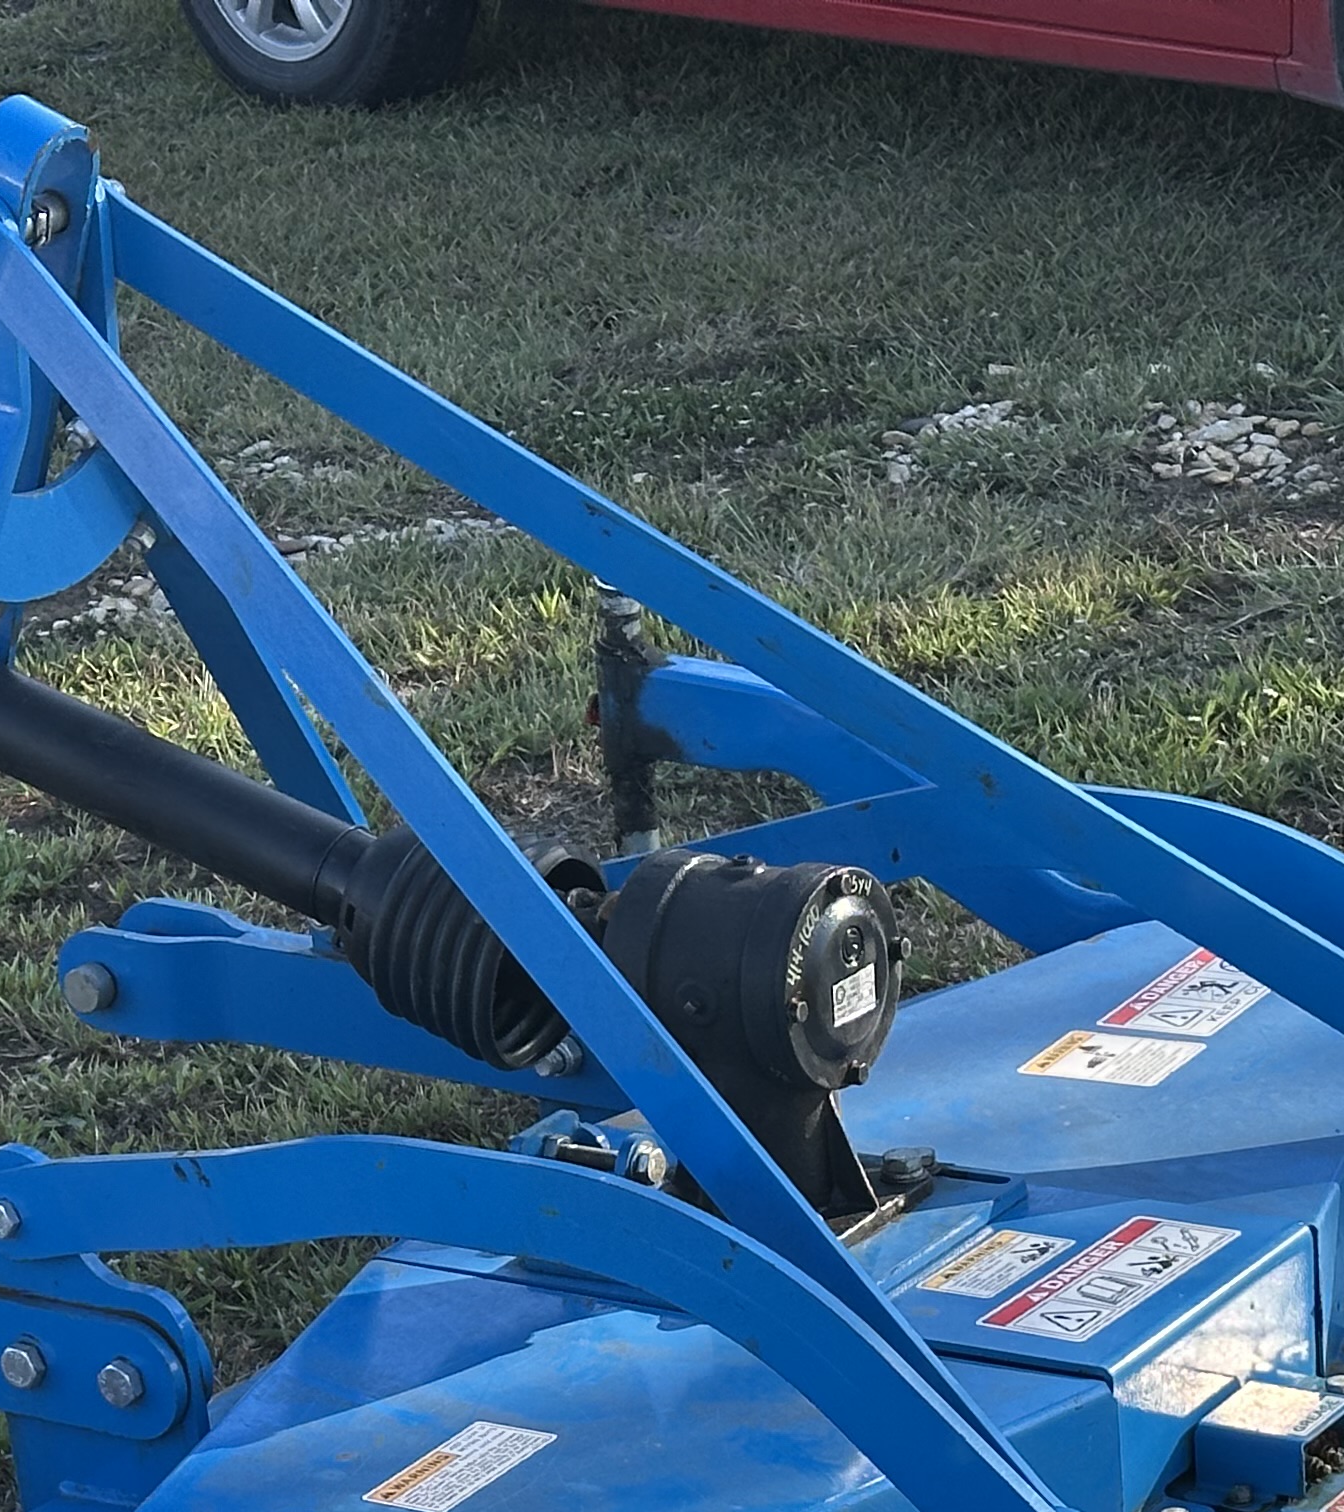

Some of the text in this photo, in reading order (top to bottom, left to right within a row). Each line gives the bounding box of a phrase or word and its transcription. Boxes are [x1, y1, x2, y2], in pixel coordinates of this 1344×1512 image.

[1144, 958, 1205, 1002] DANGER
[1047, 1240, 1125, 1292] DANGER
[390, 1454, 452, 1491] WARNING
